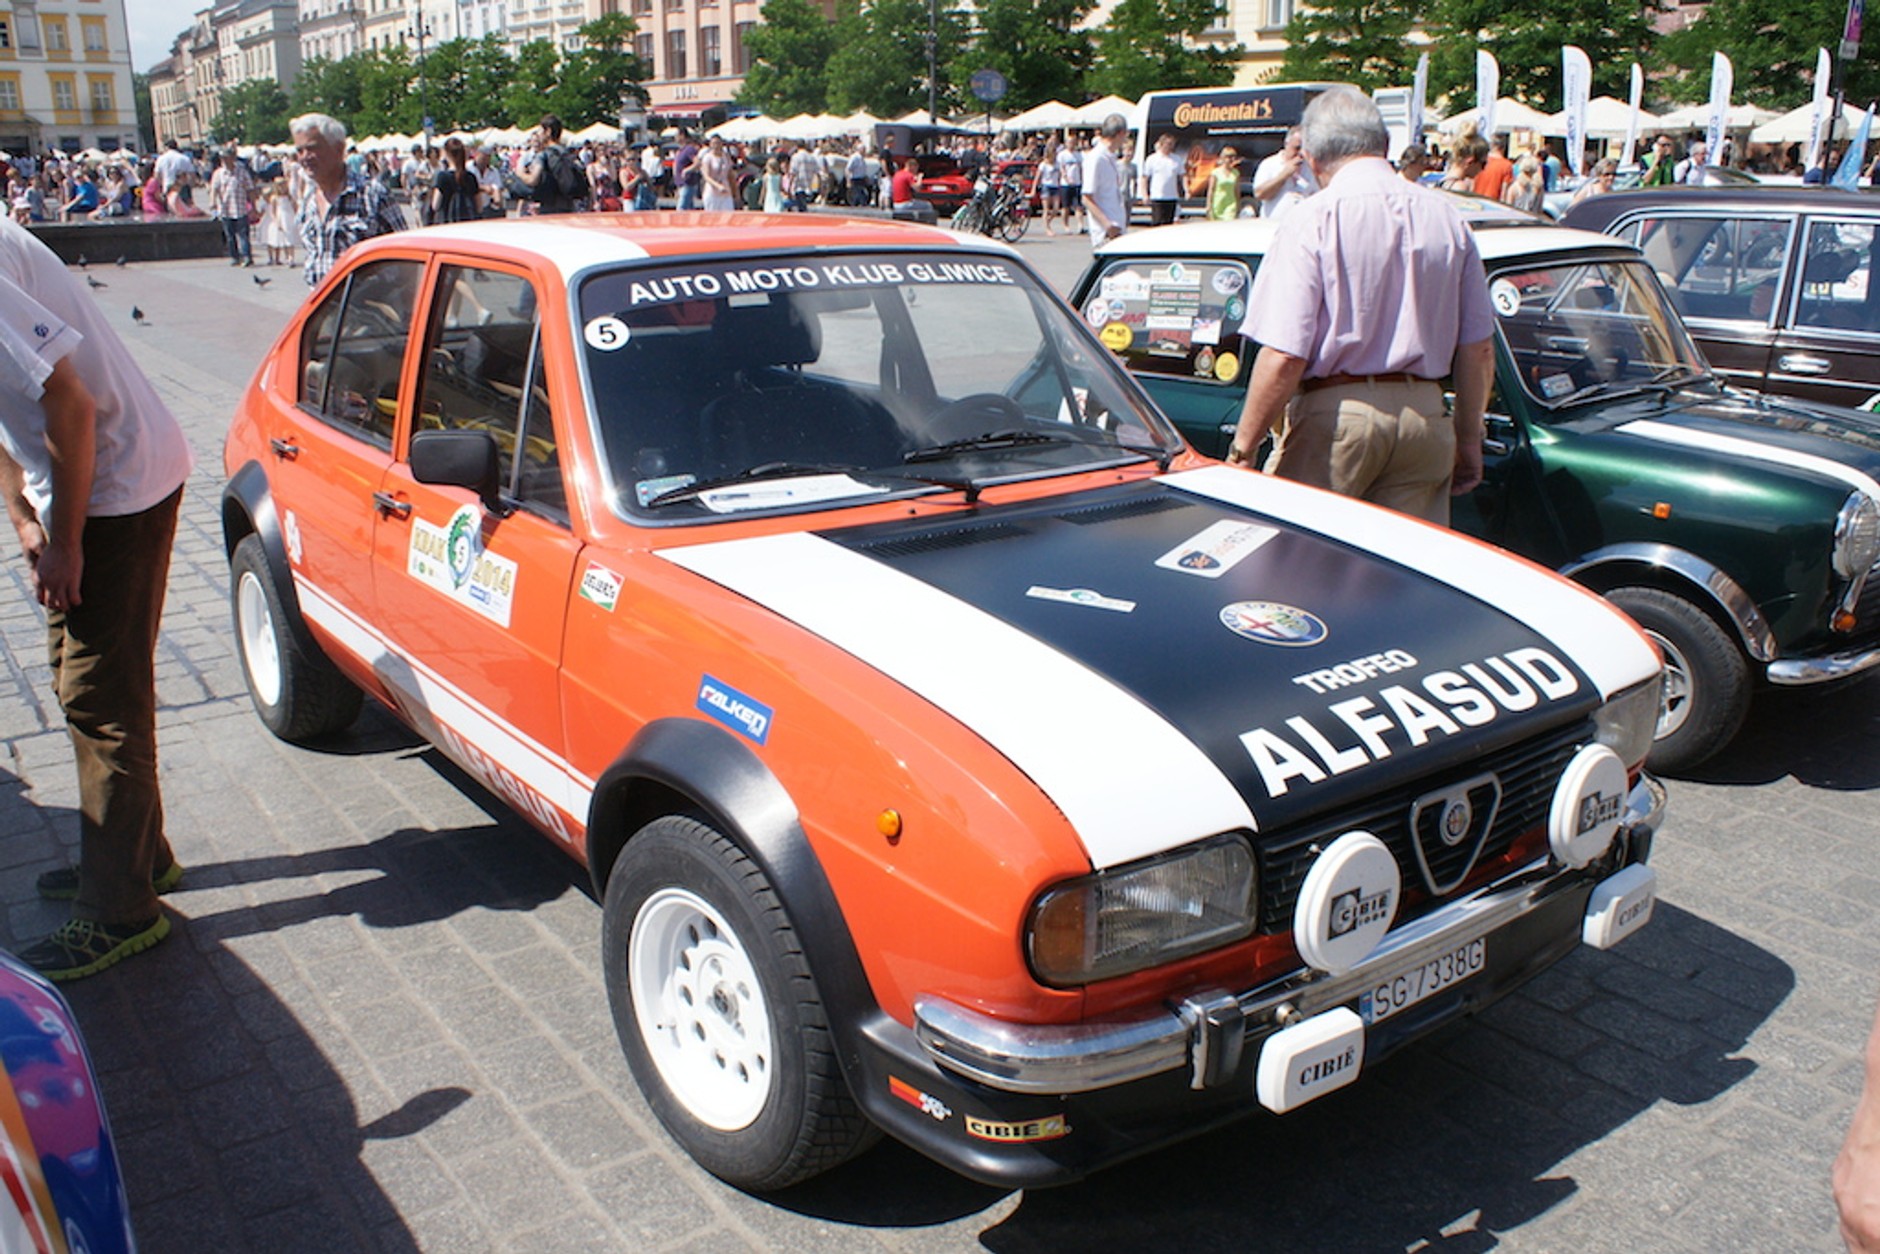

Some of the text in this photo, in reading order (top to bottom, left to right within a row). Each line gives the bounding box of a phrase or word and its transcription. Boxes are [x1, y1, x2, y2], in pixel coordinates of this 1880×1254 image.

[1174, 99, 1259, 128] Continental
[630, 262, 1015, 304] AUTO MOTO KLUB GLIWICE
[1498, 293, 1512, 311] 3
[599, 323, 617, 344] 5
[471, 554, 512, 597] 2014
[1292, 649, 1419, 695] TROFEO
[700, 684, 767, 734] FALKEN
[1239, 647, 1579, 798] ALFASUD
[1375, 939, 1482, 1016] SG 7338G
[970, 1121, 1040, 1137] CIBIE
